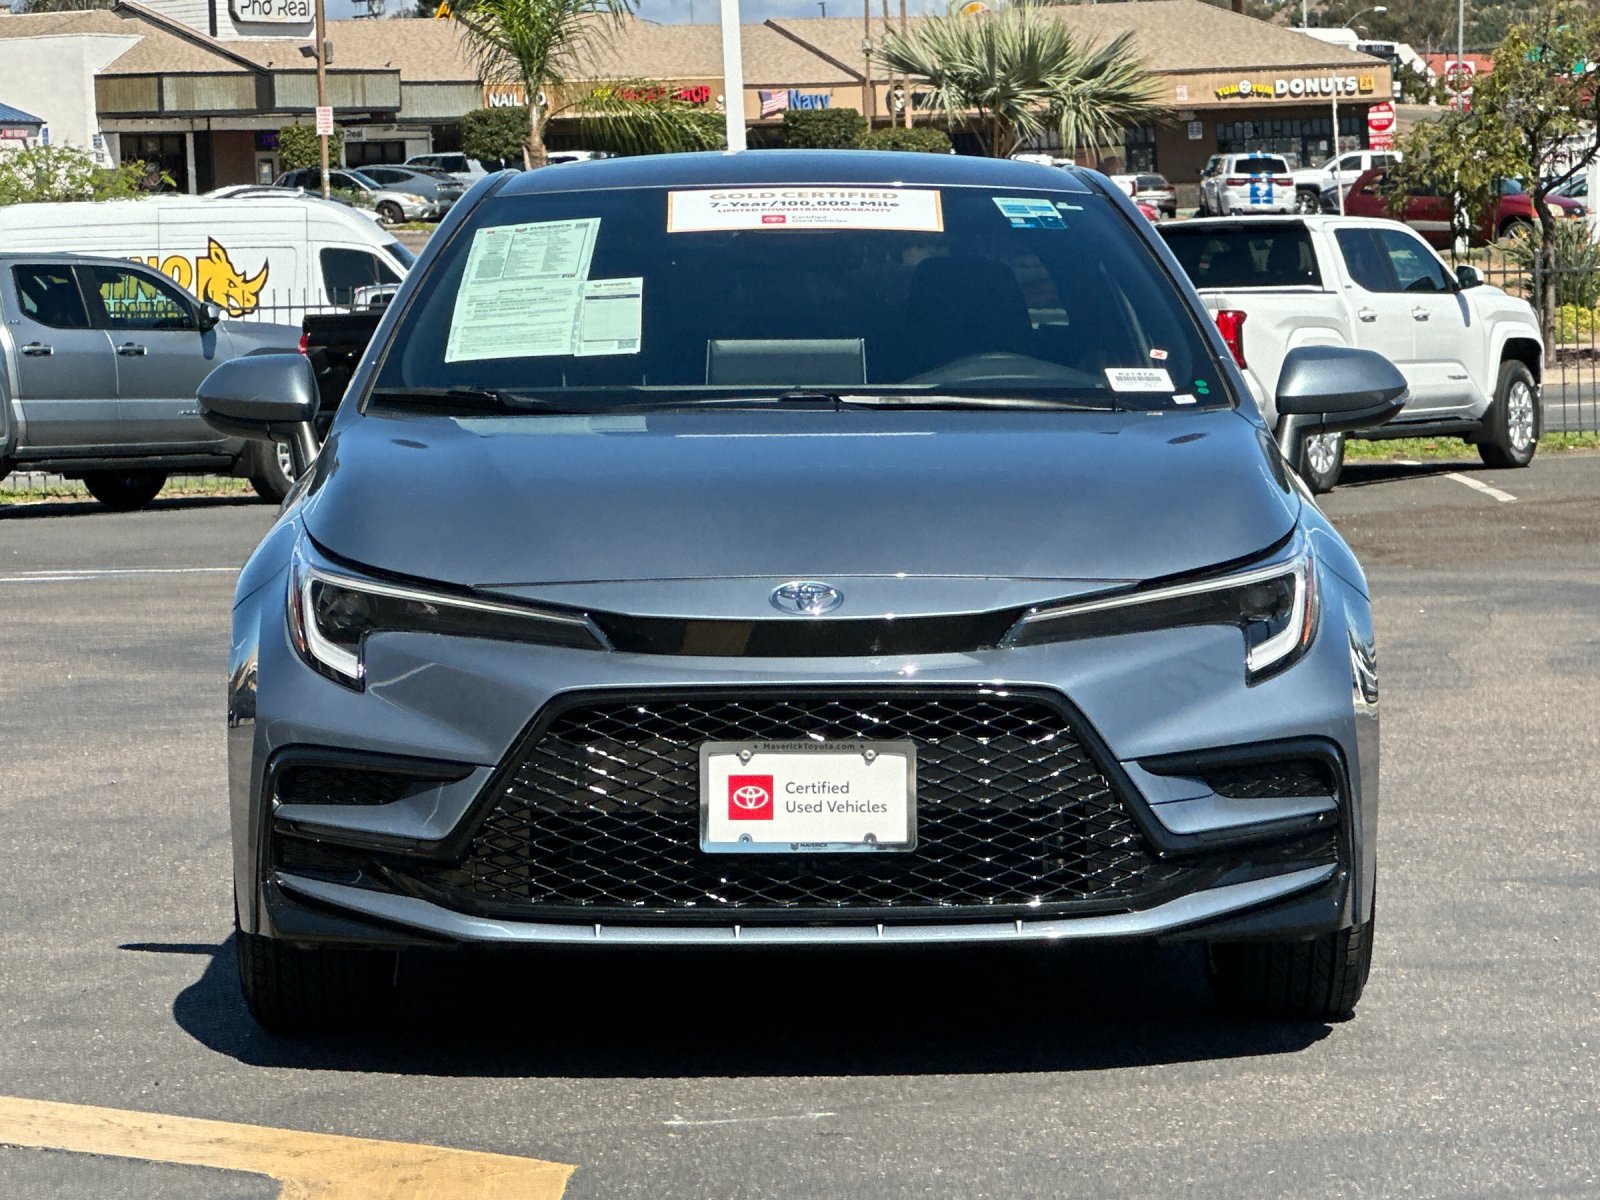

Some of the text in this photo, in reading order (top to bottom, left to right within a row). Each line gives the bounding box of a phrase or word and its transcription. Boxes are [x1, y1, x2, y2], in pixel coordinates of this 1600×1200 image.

[240, 0, 310, 16] Pho Real
[1216, 76, 1358, 97] YUM YUM DONUTS
[1361, 78, 1373, 87] 24
[488, 92, 522, 107] NAIL
[788, 88, 831, 109] Navy
[709, 200, 899, 208] 7-Year/100,000-Mile
[763, 743, 855, 751] MaverickToyota.com
[785, 781, 850, 795] Certified
[785, 800, 888, 813] Used Vehicles
